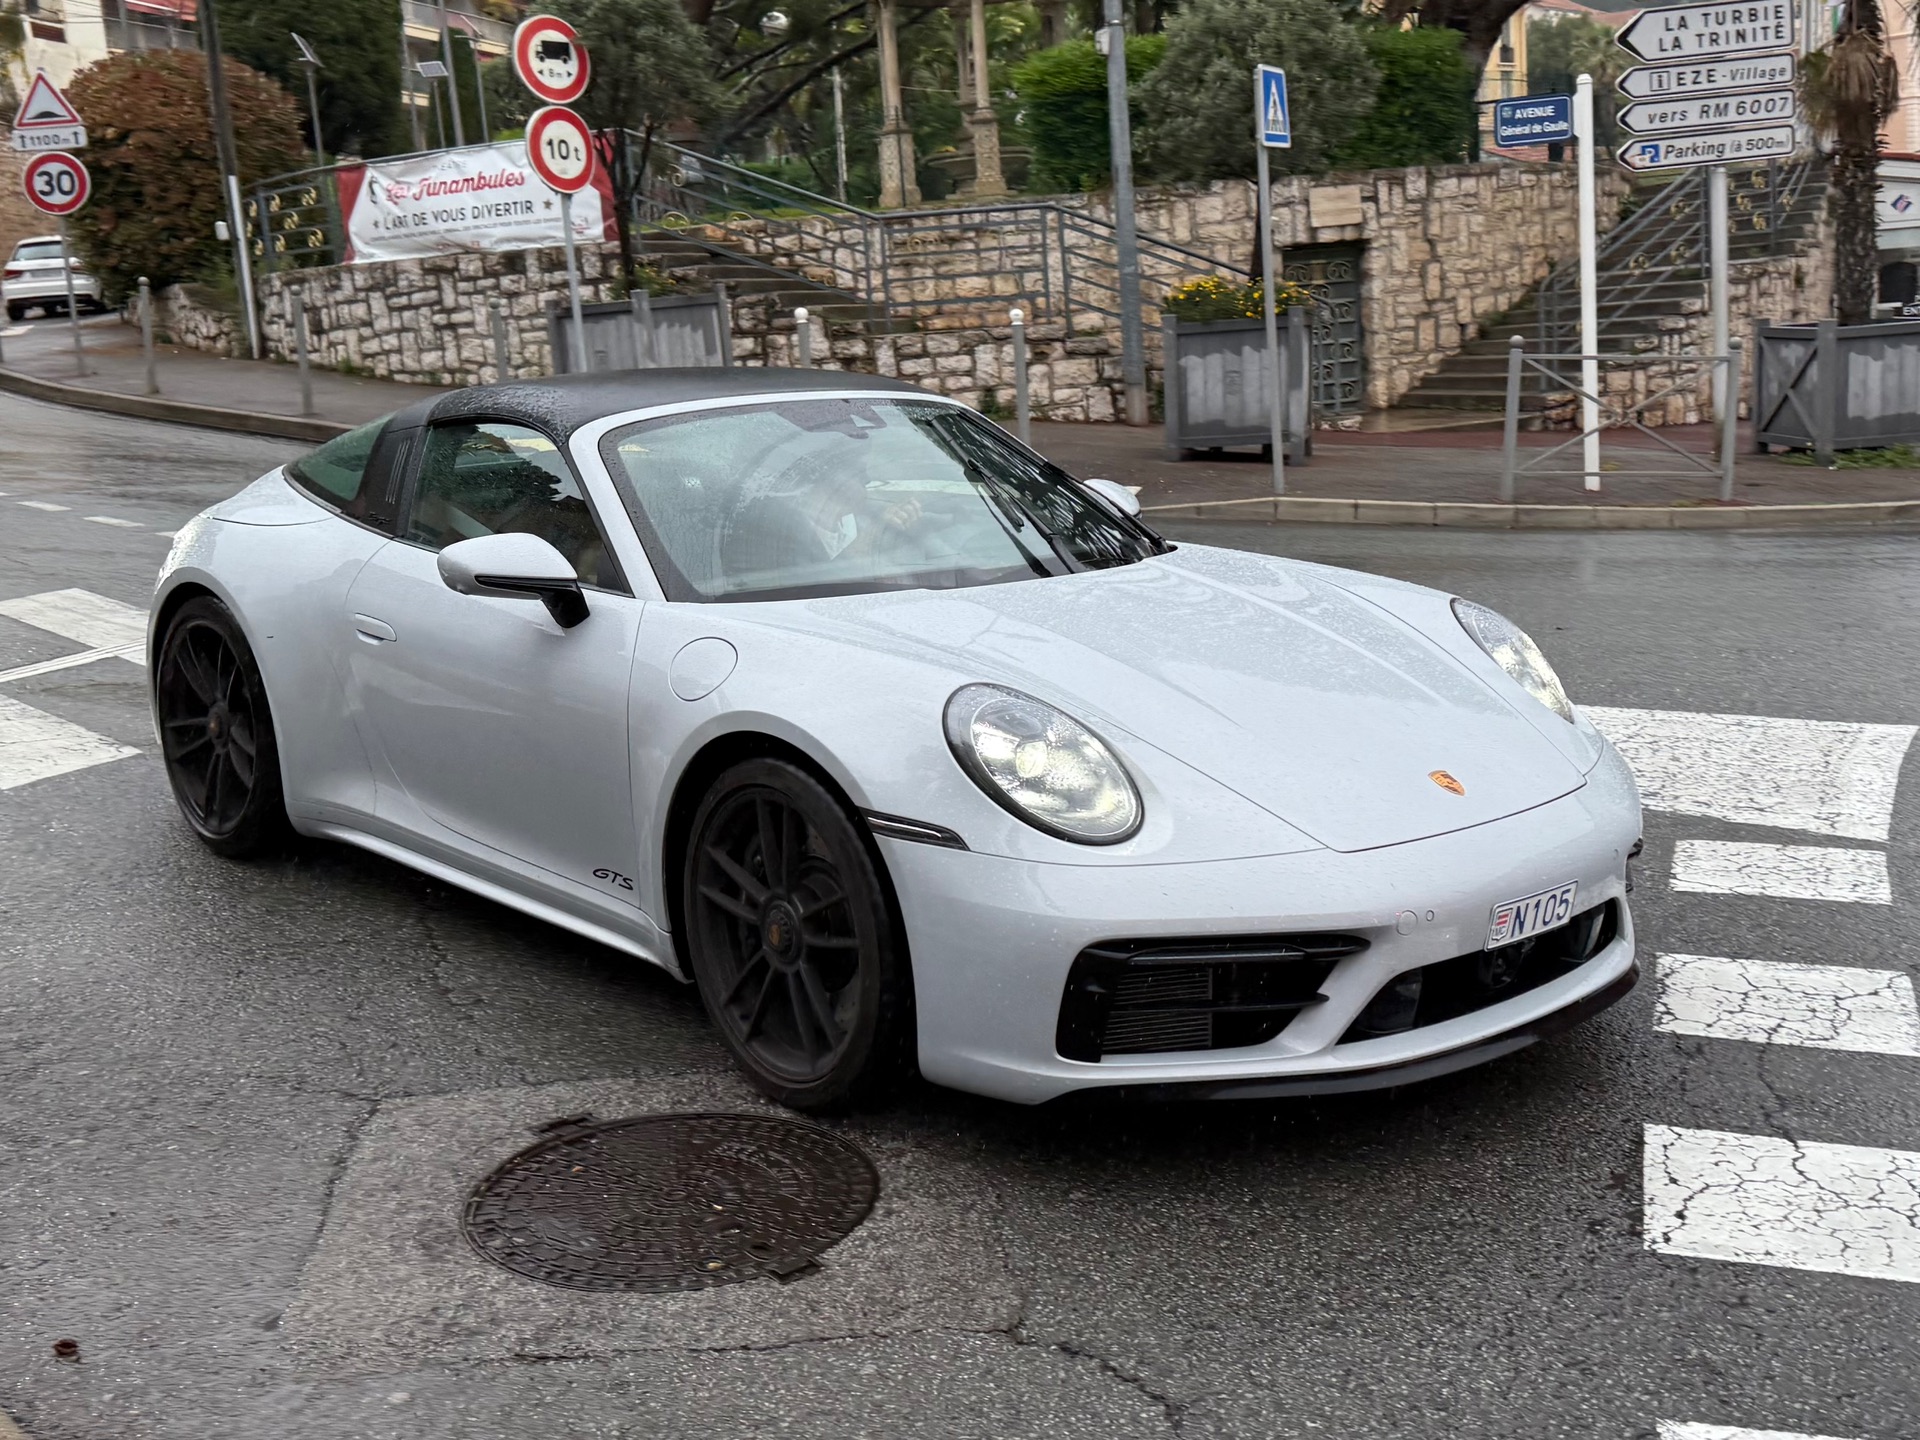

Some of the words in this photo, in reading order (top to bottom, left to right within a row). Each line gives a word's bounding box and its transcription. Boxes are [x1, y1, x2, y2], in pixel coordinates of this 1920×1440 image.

[1664, 15, 1689, 32] LA
[1701, 4, 1785, 28] TURBIE
[1658, 36, 1682, 52] LA
[1695, 21, 1785, 48] TRINITÉ
[1515, 105, 1556, 119] AVENUE
[1647, 109, 1688, 124] vers
[1699, 102, 1729, 119] RM
[1735, 97, 1789, 116] 6007
[1532, 123, 1542, 133] de
[1543, 120, 1569, 132] Gaulle
[1663, 141, 1726, 159] Parking
[36, 170, 76, 197] 30
[412, 169, 525, 200] Funambules
[412, 212, 429, 226] DE
[431, 207, 466, 223] VOUS
[472, 200, 534, 219] DIVERTIR
[593, 868, 634, 891] GTS
[1511, 888, 1572, 938] N105
